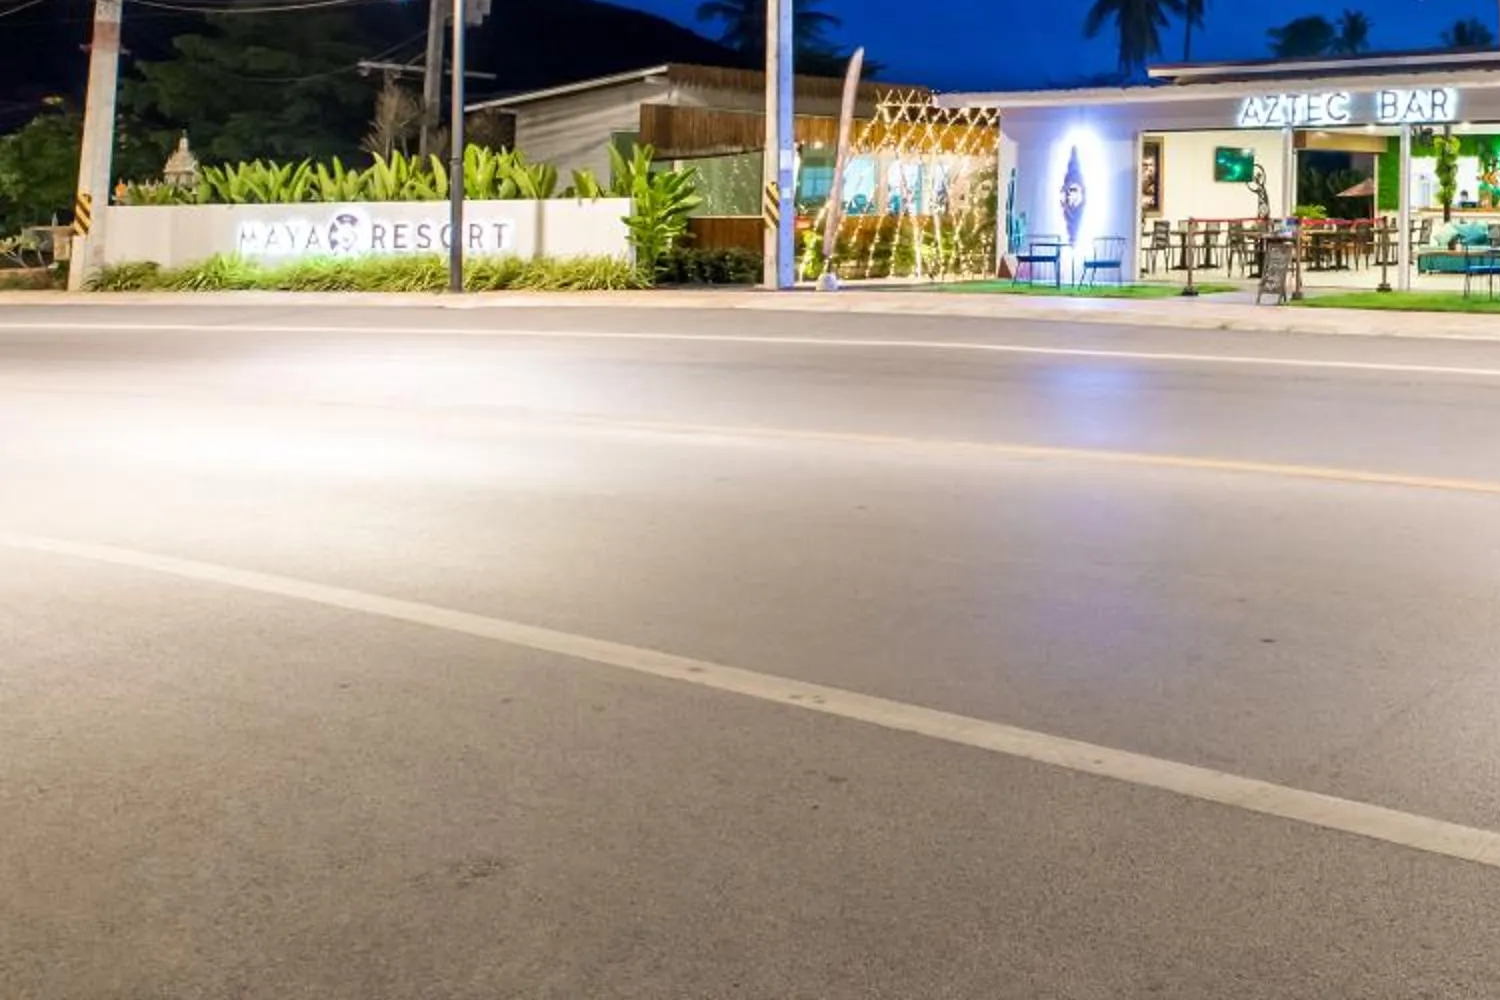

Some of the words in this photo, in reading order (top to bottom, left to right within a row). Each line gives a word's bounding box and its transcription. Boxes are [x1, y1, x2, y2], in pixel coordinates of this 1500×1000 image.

[1240, 93, 1348, 125] AZTEC
[1380, 88, 1448, 120] BAR
[240, 223, 321, 250] MAYA
